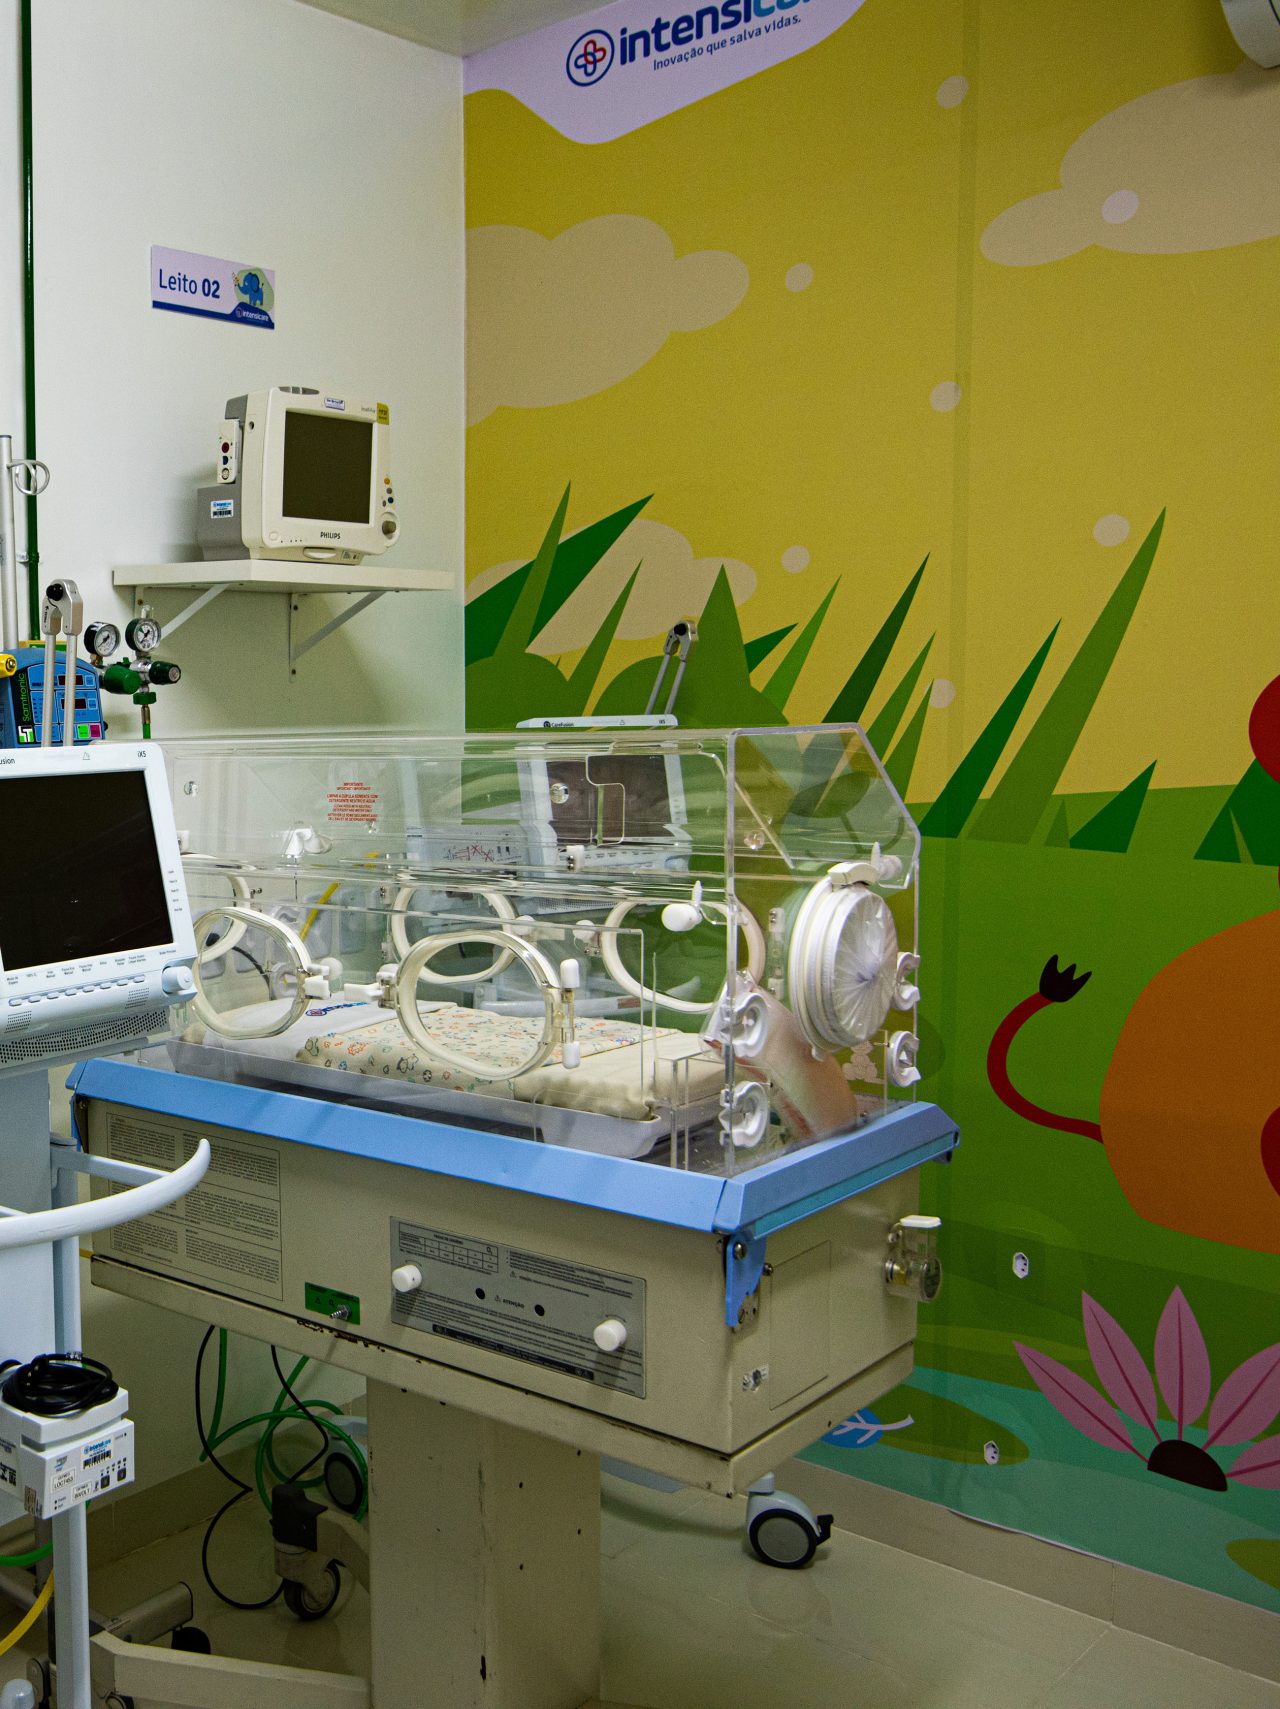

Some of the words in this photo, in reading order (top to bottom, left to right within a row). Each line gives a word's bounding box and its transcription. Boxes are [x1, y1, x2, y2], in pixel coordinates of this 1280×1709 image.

[620, 0, 810, 66] intensic
[653, 47, 704, 71] Inovação
[706, 39, 727, 55] que
[729, 27, 762, 46] salva
[764, 14, 802, 34] vidas.
[159, 268, 198, 295] Leito
[201, 278, 220, 299] 02
[242, 310, 269, 321] intensicare
[320, 531, 341, 539] PHILIPS
[19, 673, 30, 722] Samtronic
